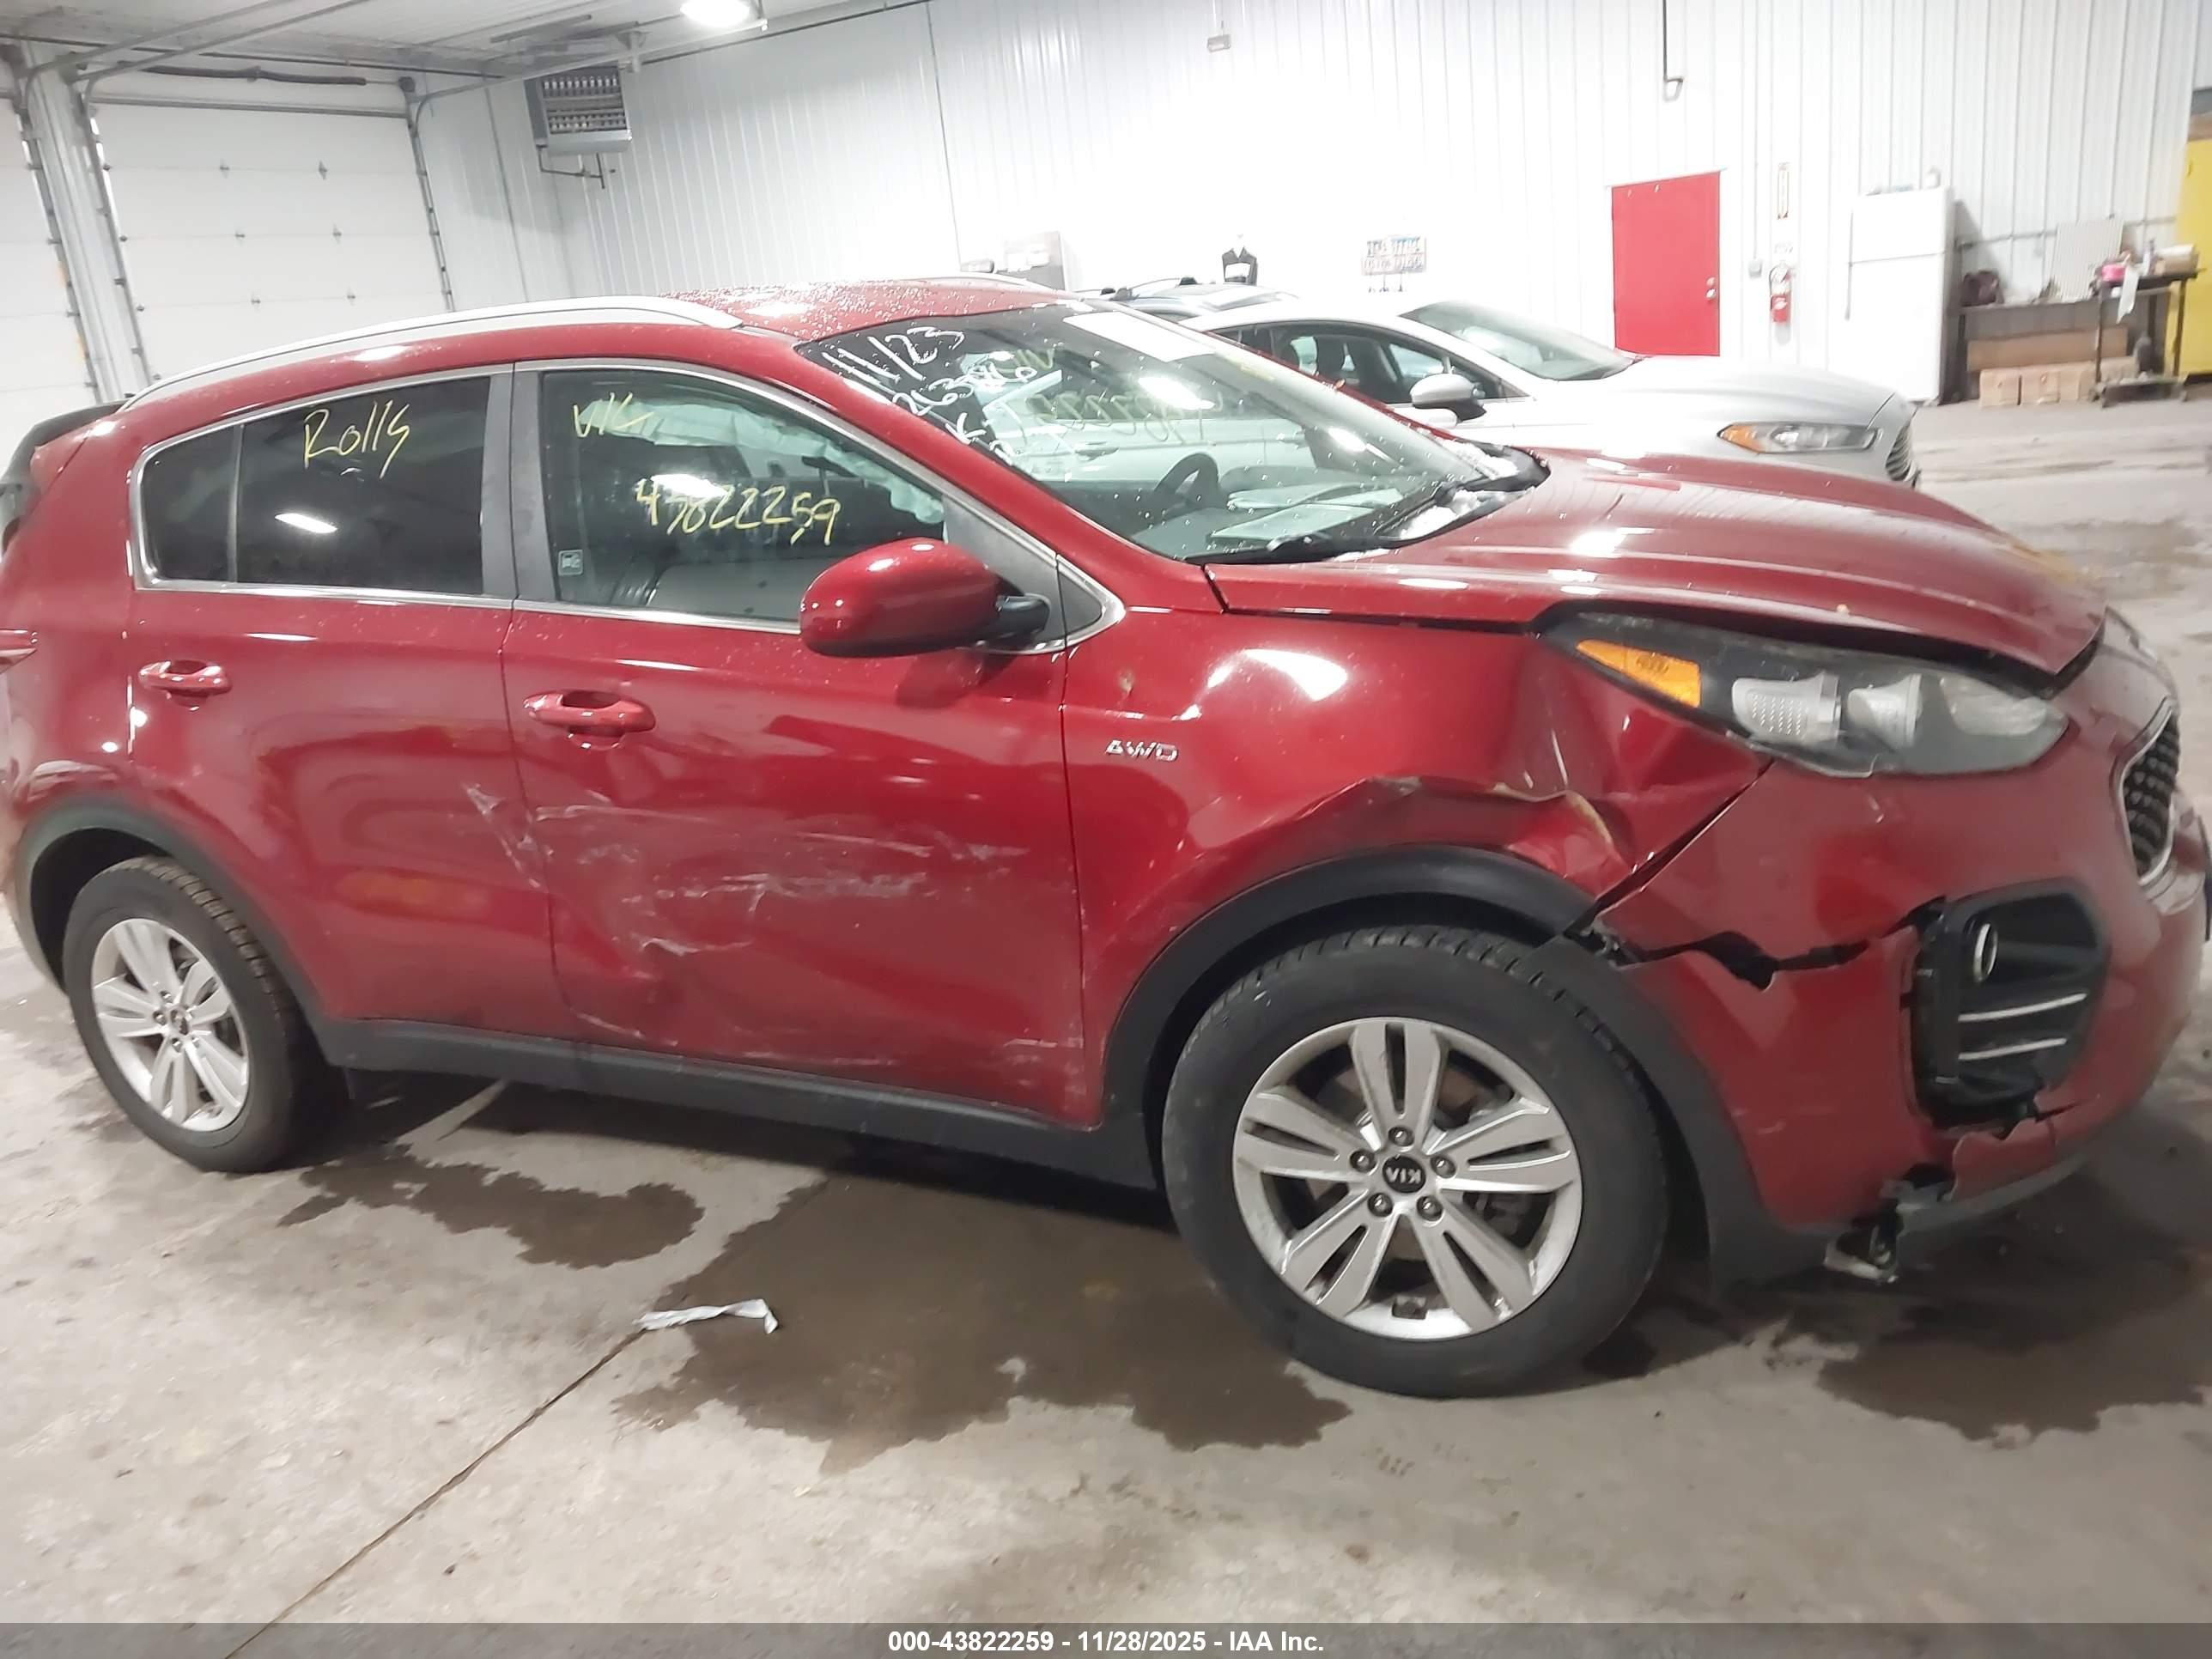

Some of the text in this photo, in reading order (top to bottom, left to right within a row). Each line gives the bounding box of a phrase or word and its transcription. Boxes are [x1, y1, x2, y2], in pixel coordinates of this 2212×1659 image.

[821, 326, 966, 386] 11/23
[1106, 739, 1178, 762] AWD
[1385, 1167, 1422, 1184] KIA
